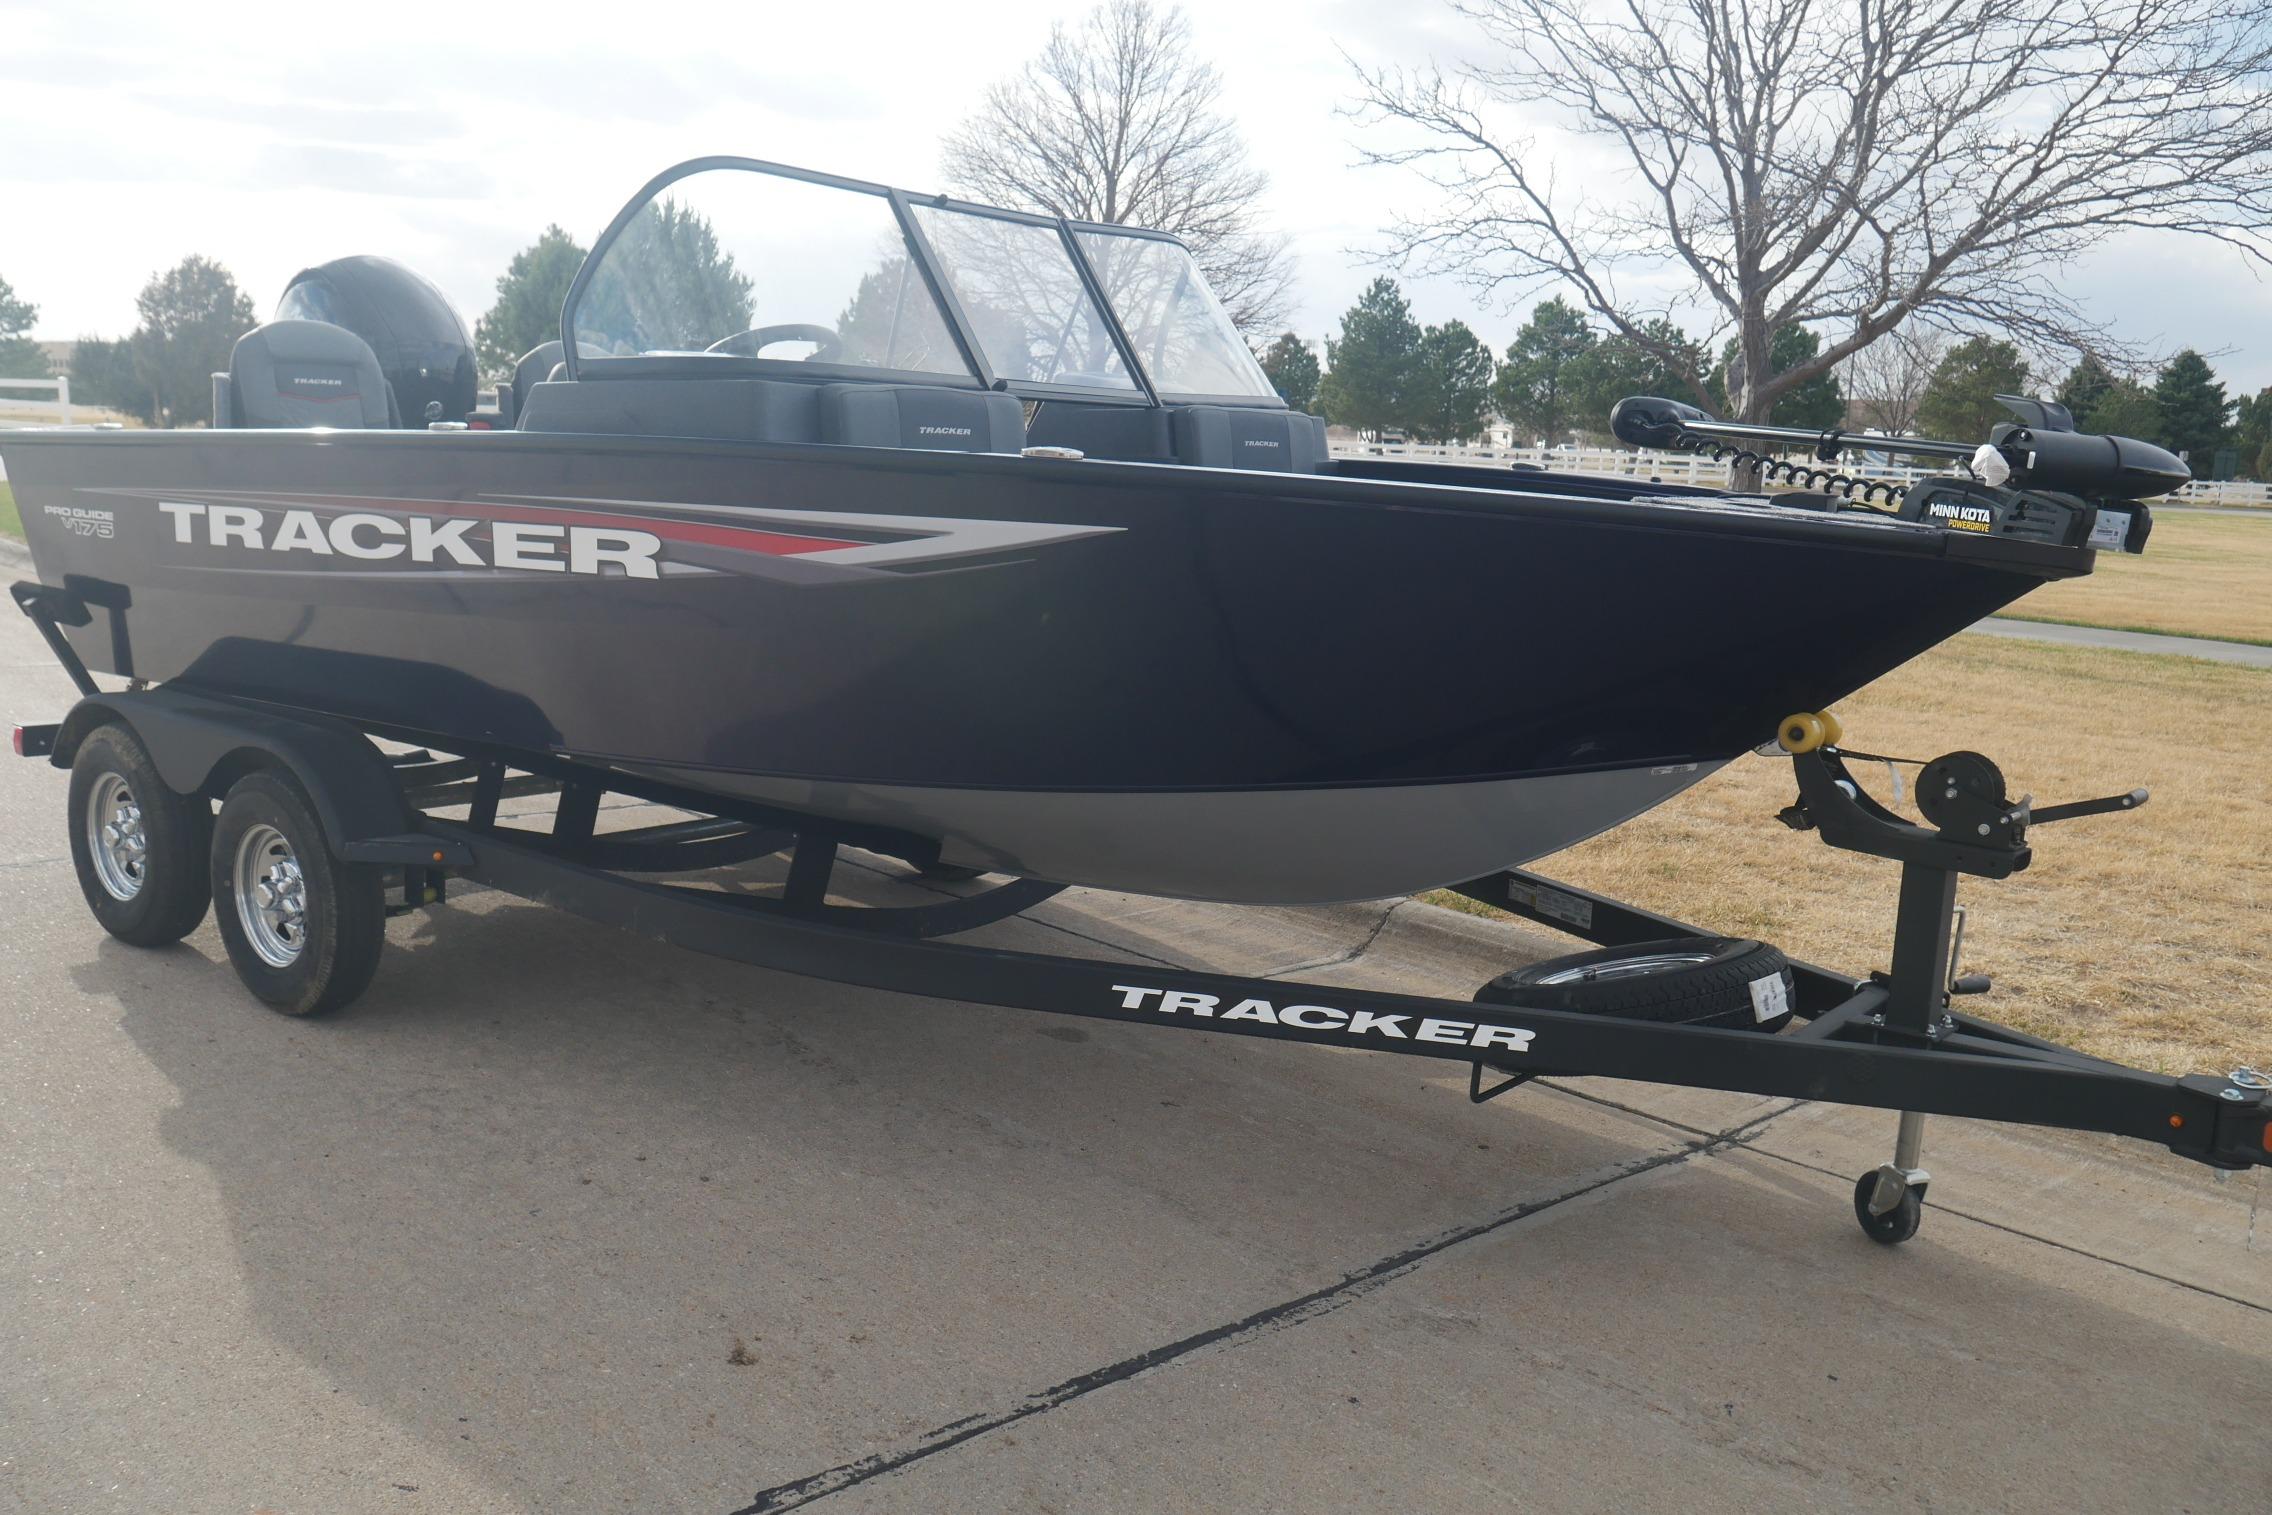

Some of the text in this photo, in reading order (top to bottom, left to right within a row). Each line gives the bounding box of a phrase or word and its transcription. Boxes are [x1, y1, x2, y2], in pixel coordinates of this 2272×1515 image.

[919, 426, 971, 435] TRACKER
[44, 505, 114, 520] PRO GUIDE
[1930, 503, 1990, 523] MINN KOTA
[60, 516, 114, 538] V175
[1948, 519, 1990, 532] POWERDRIVE
[158, 502, 662, 579] TRACKER
[1112, 985, 1537, 1052] TRACKER
